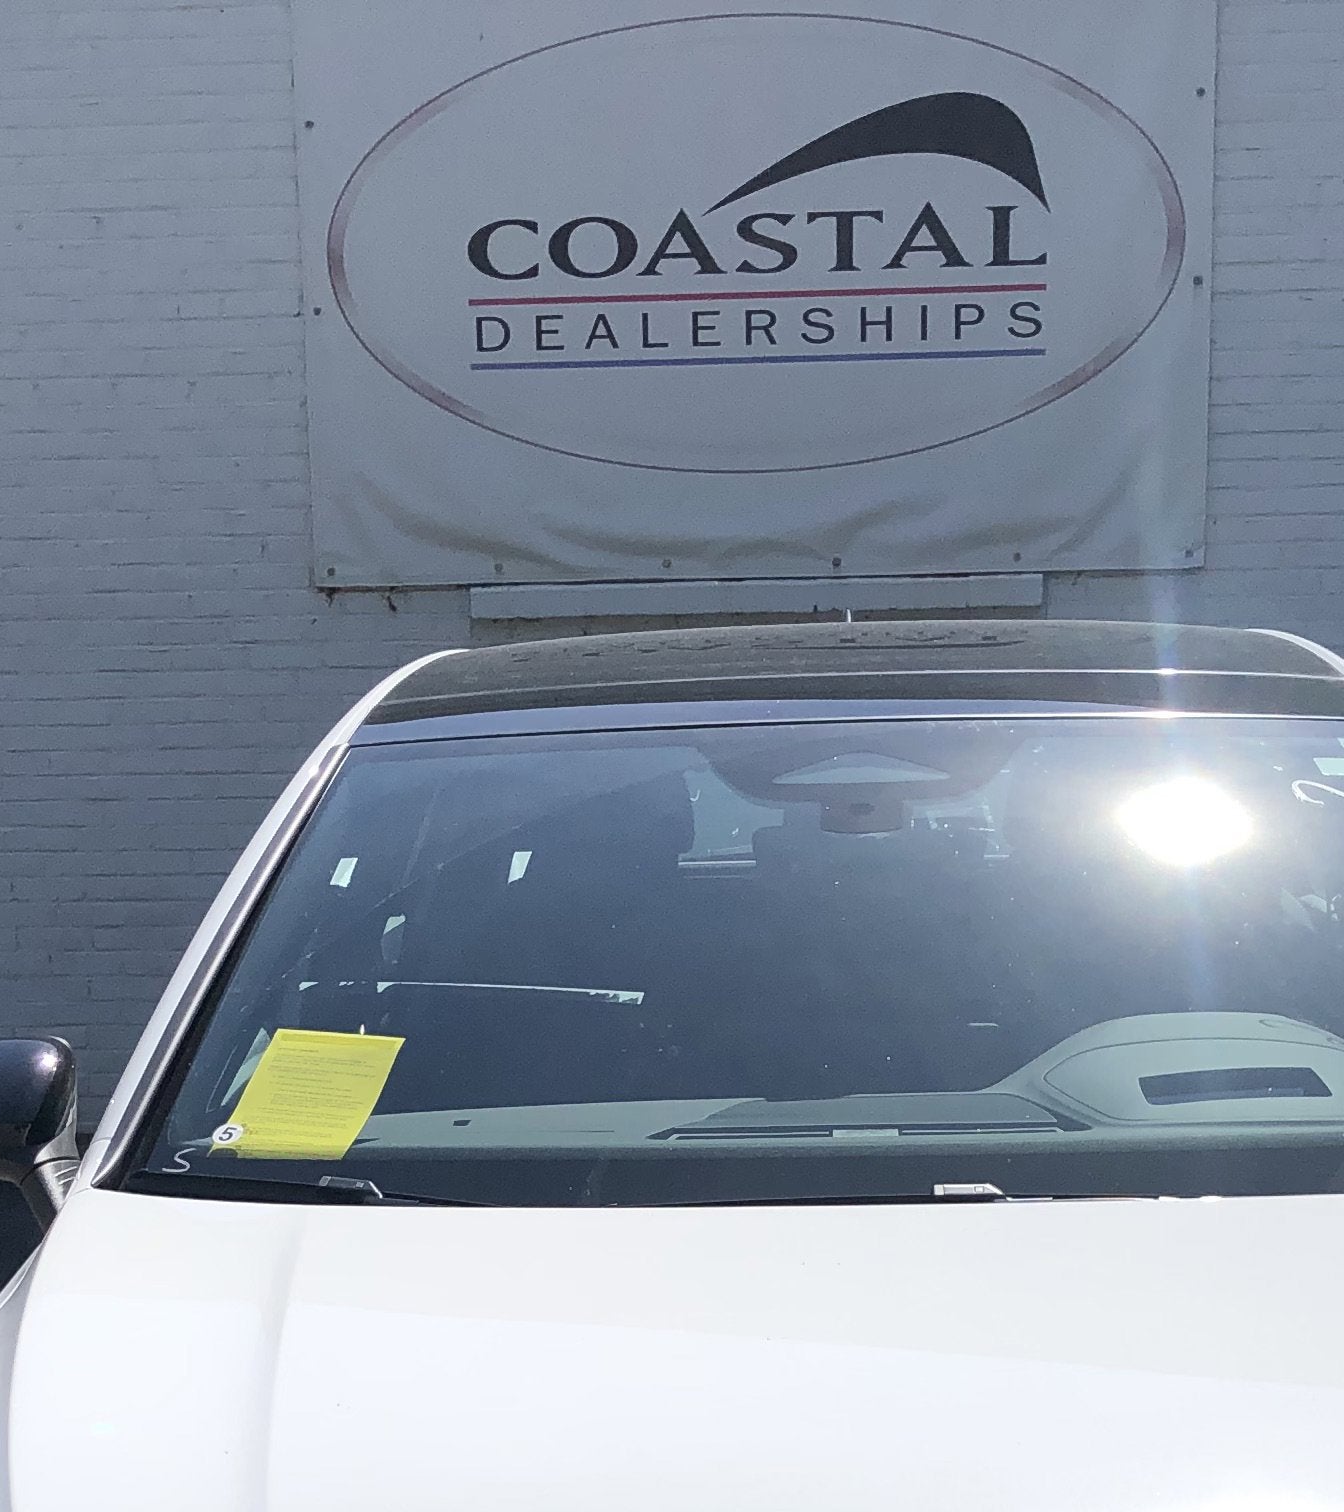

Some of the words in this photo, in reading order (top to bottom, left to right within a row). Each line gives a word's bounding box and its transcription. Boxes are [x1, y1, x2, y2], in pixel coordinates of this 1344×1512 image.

[466, 200, 1048, 281] COASTAL
[474, 300, 1044, 353] DEALERSHIPS
[218, 1126, 238, 1142] 5
